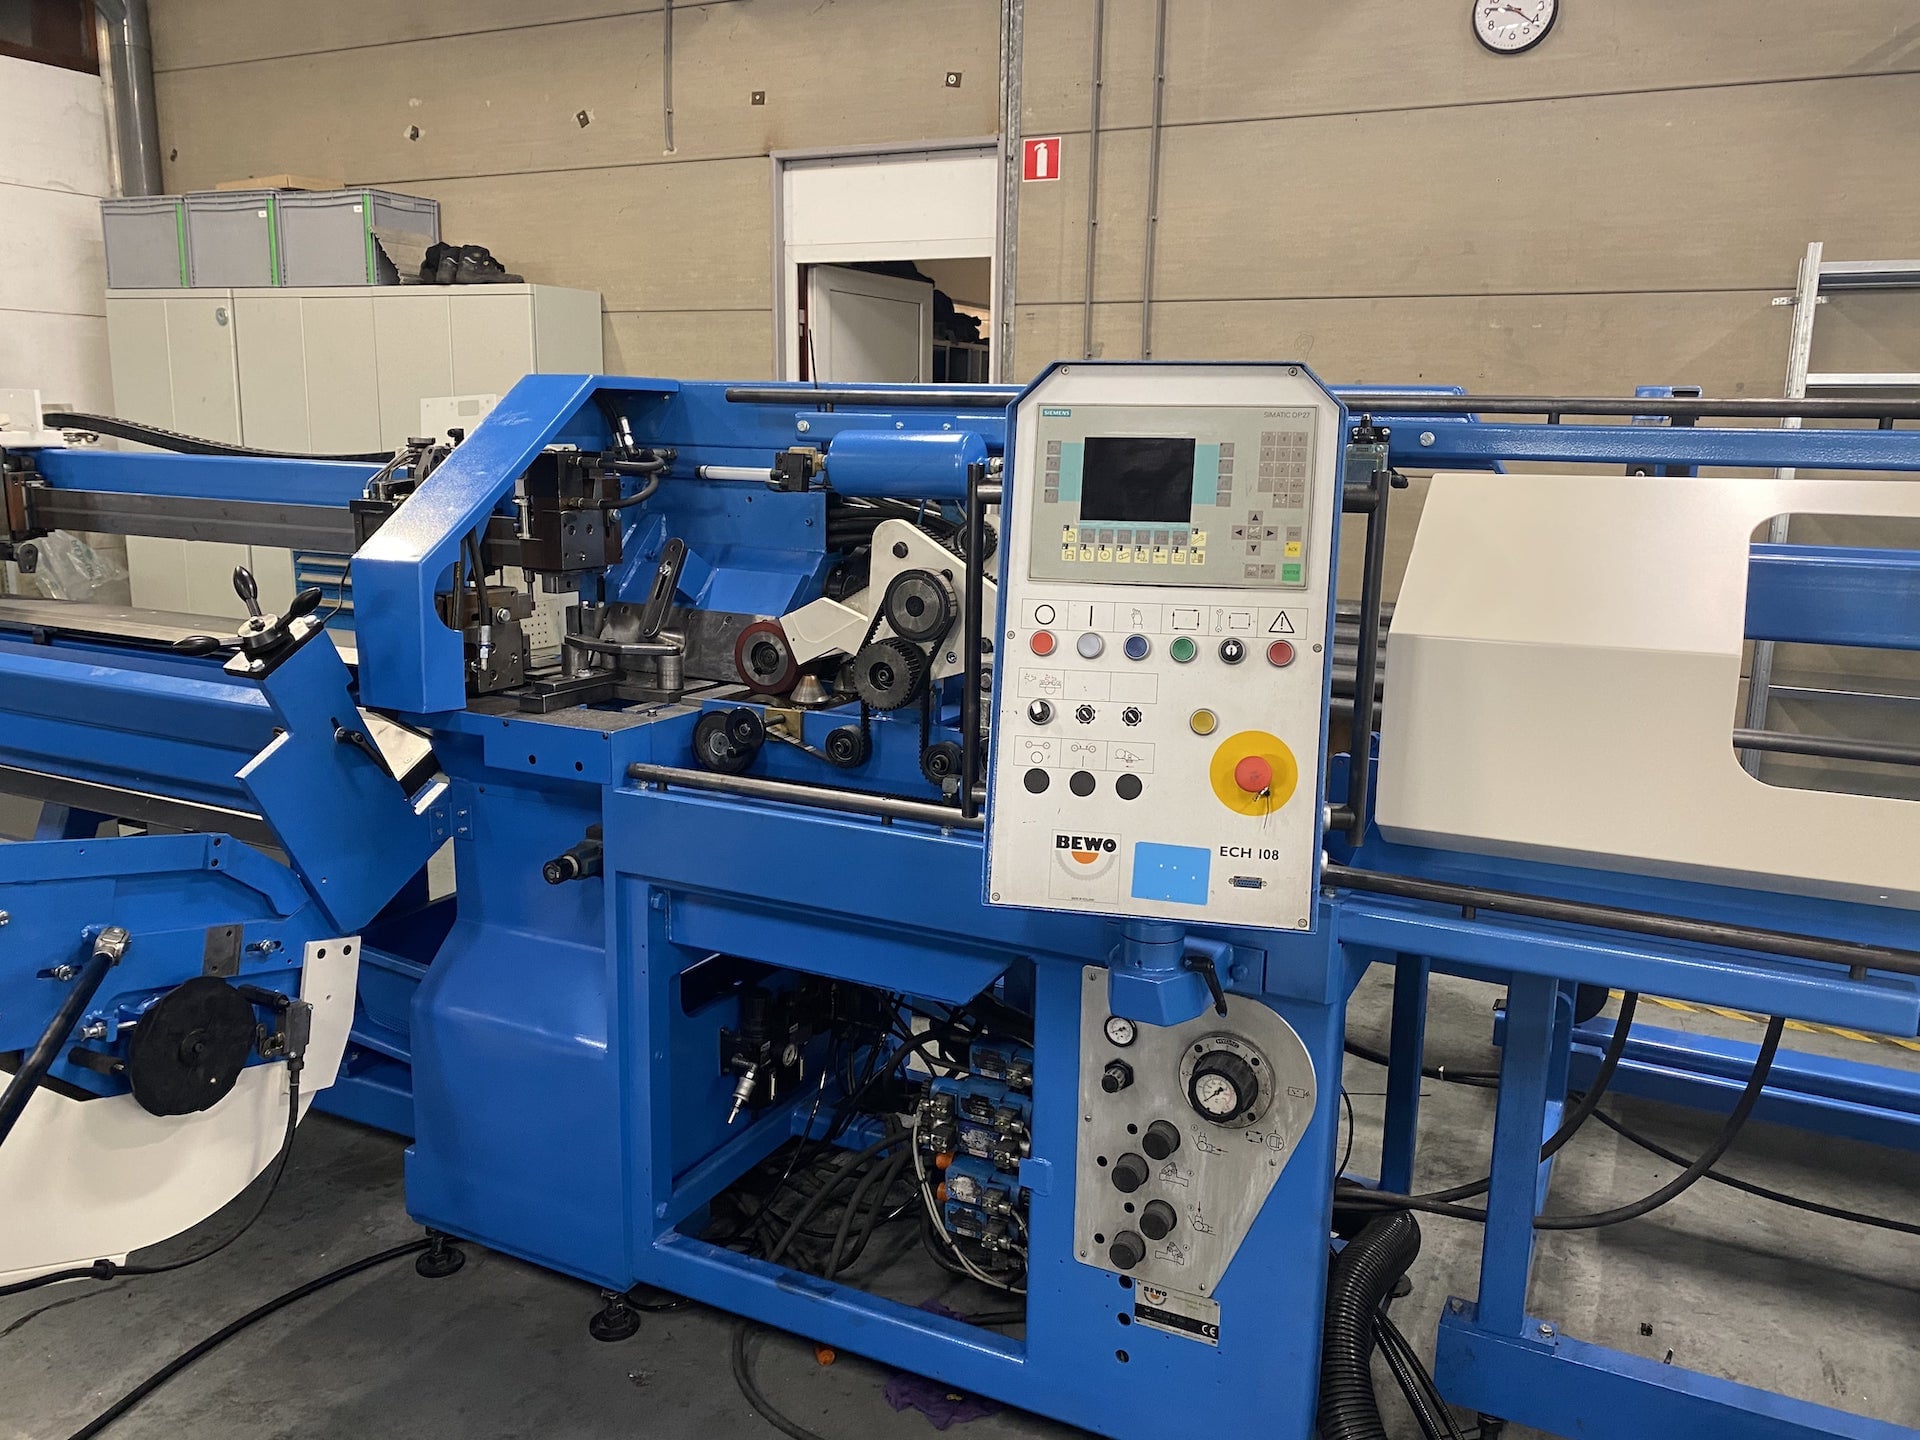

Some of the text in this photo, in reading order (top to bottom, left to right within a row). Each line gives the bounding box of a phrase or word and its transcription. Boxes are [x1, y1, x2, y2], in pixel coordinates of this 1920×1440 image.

[1538, 1, 1544, 11] 3
[1488, 20, 1494, 30] 8
[1509, 31, 1516, 40] 6
[1523, 26, 1530, 35] 5
[1043, 409, 1070, 417] SIEMENS
[1263, 411, 1290, 419] SIMATIC
[1056, 834, 1117, 853] BEWO
[1219, 846, 1280, 861] ECH 108
[1143, 1286, 1168, 1297] BEWO
